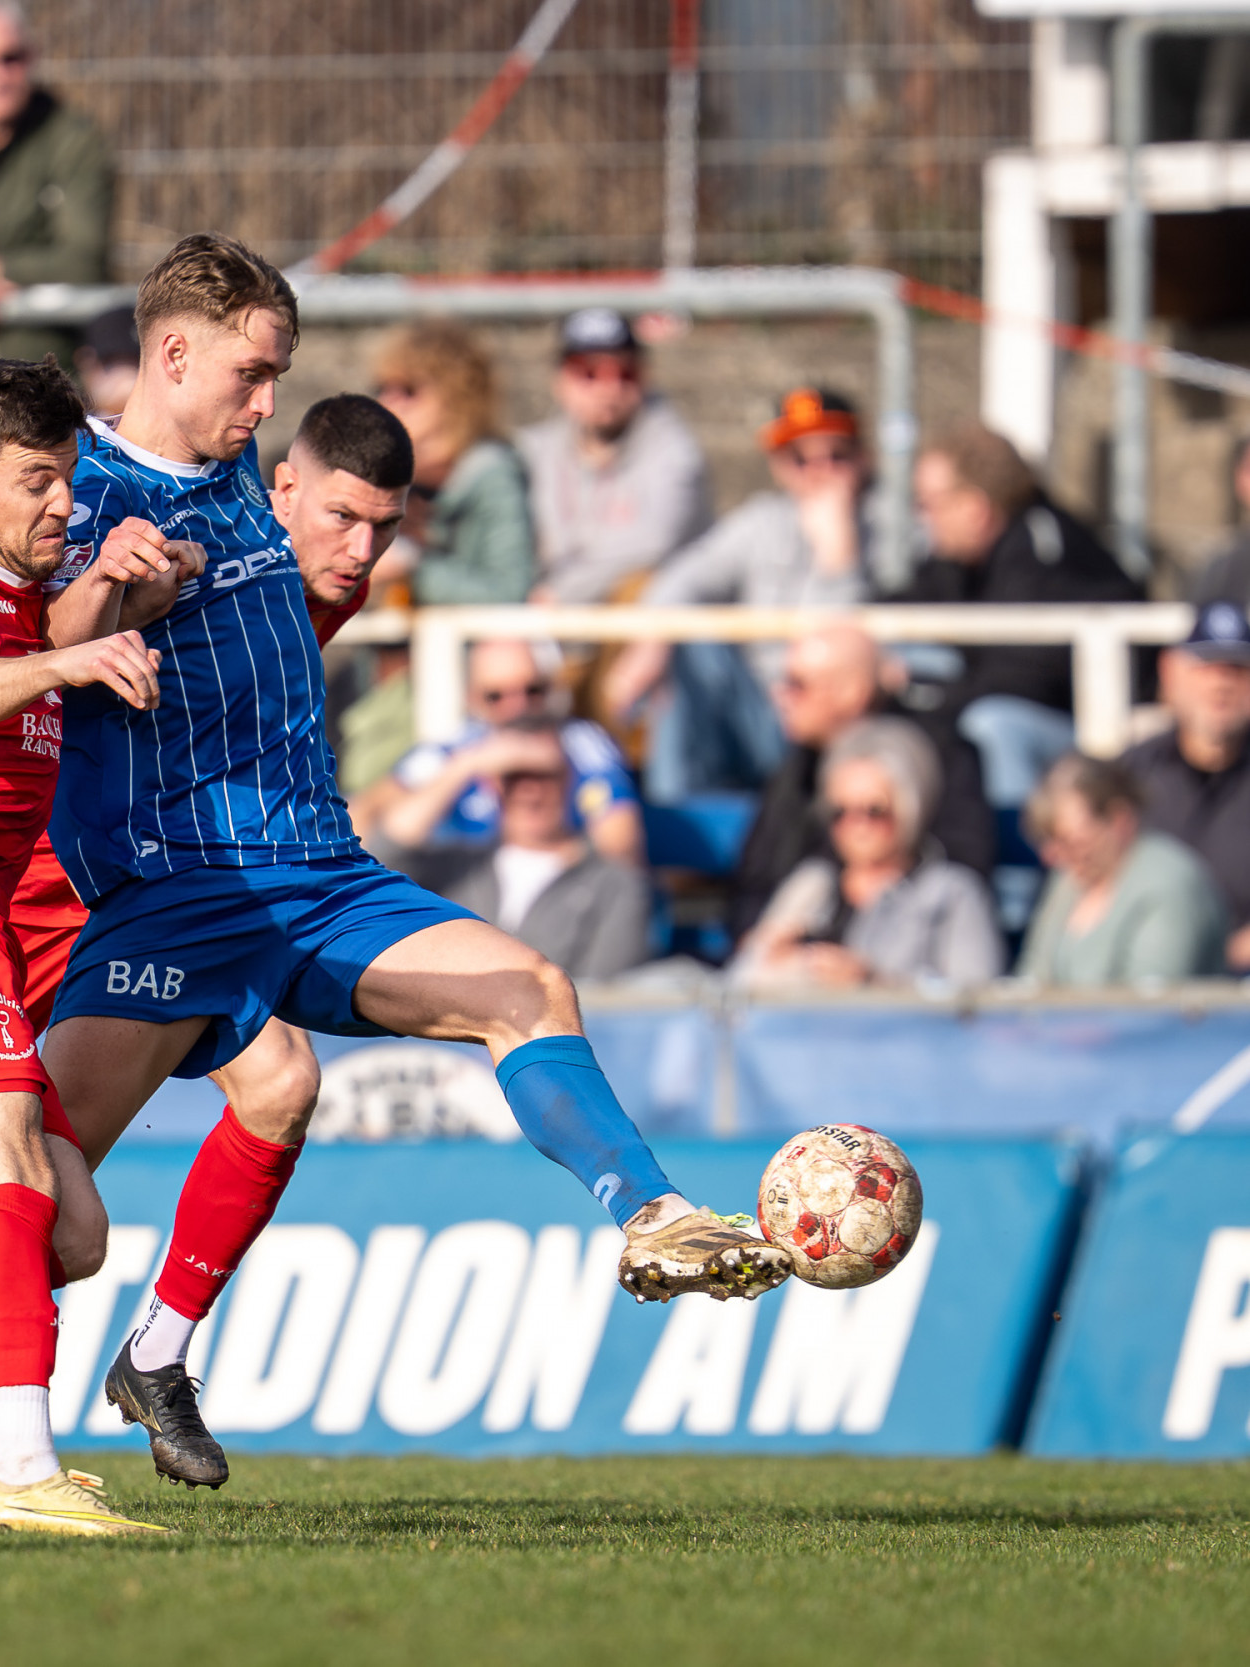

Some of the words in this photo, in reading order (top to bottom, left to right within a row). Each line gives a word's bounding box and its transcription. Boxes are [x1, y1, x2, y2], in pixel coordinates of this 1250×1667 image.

[107, 960, 185, 1001] BAB
[622, 1222, 940, 1435] AM
[1161, 1226, 1250, 1440] P
